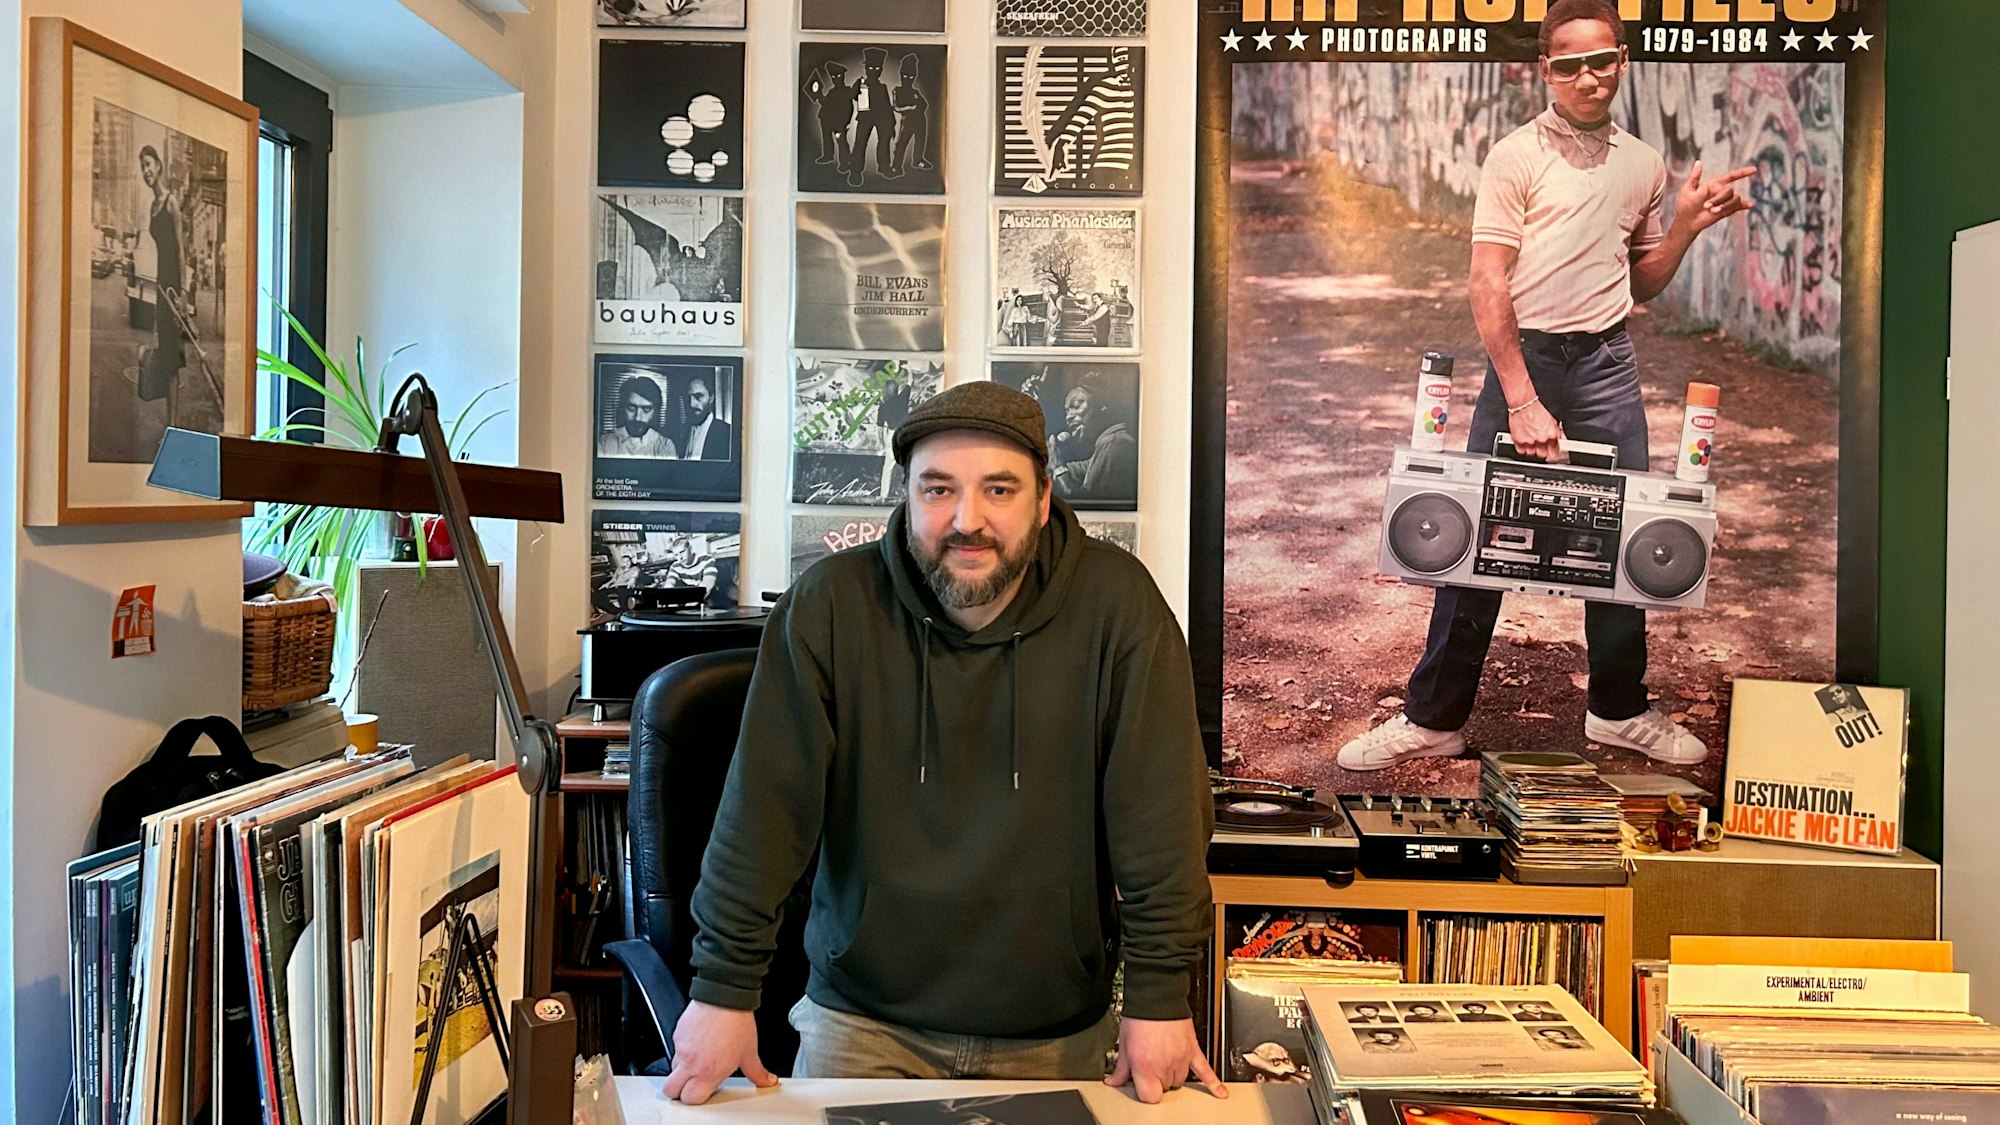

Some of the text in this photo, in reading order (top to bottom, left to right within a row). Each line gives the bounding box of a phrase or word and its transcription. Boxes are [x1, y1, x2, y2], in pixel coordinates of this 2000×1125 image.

[1322, 27, 1487, 53] PHOTOGRAPHS
[1642, 27, 1768, 53] 1979-1984
[1002, 213, 1132, 229] Musica Phantastica
[857, 275, 928, 289] BILL EVANS
[861, 290, 924, 302] JIM HALL
[600, 302, 735, 325] bauhaus
[854, 306, 928, 316] UNDERCURRENT
[795, 411, 829, 447] CUT
[827, 387, 866, 418] THE
[602, 522, 643, 530] STIEBER
[1834, 712, 1883, 748] OUT!
[1725, 805, 1797, 840] JACKIE
[1421, 844, 1459, 853] KONTRAPUNKT
[1798, 991, 1834, 1002] AMBIENT
[1920, 1114, 1934, 1122] way
[1935, 1112, 1943, 1120] of
[1944, 1113, 1967, 1122] seeing
